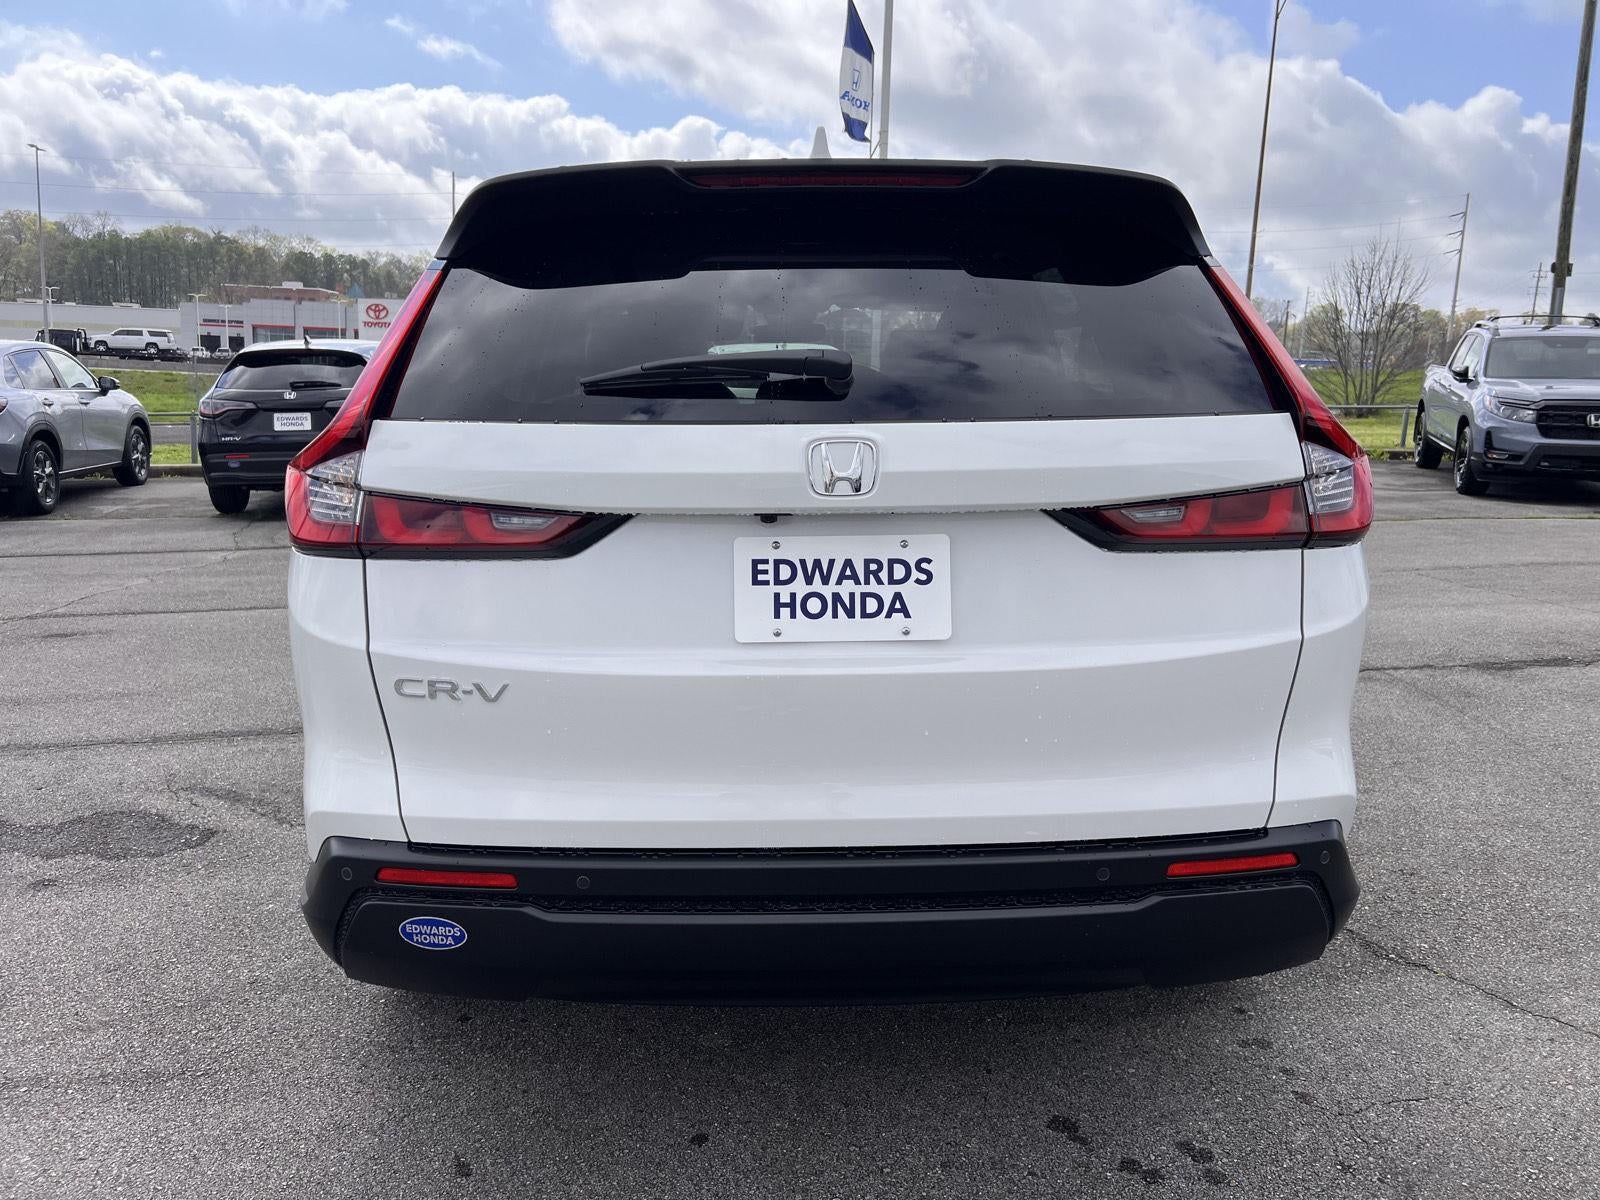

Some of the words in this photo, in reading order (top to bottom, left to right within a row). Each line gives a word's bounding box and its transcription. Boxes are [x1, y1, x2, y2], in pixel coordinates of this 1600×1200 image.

[751, 557, 934, 586] EDWARDS
[773, 591, 912, 620] HONDA
[394, 678, 509, 702] CR-V
[405, 923, 461, 937] EDWARDS
[412, 933, 455, 945] HONDA
